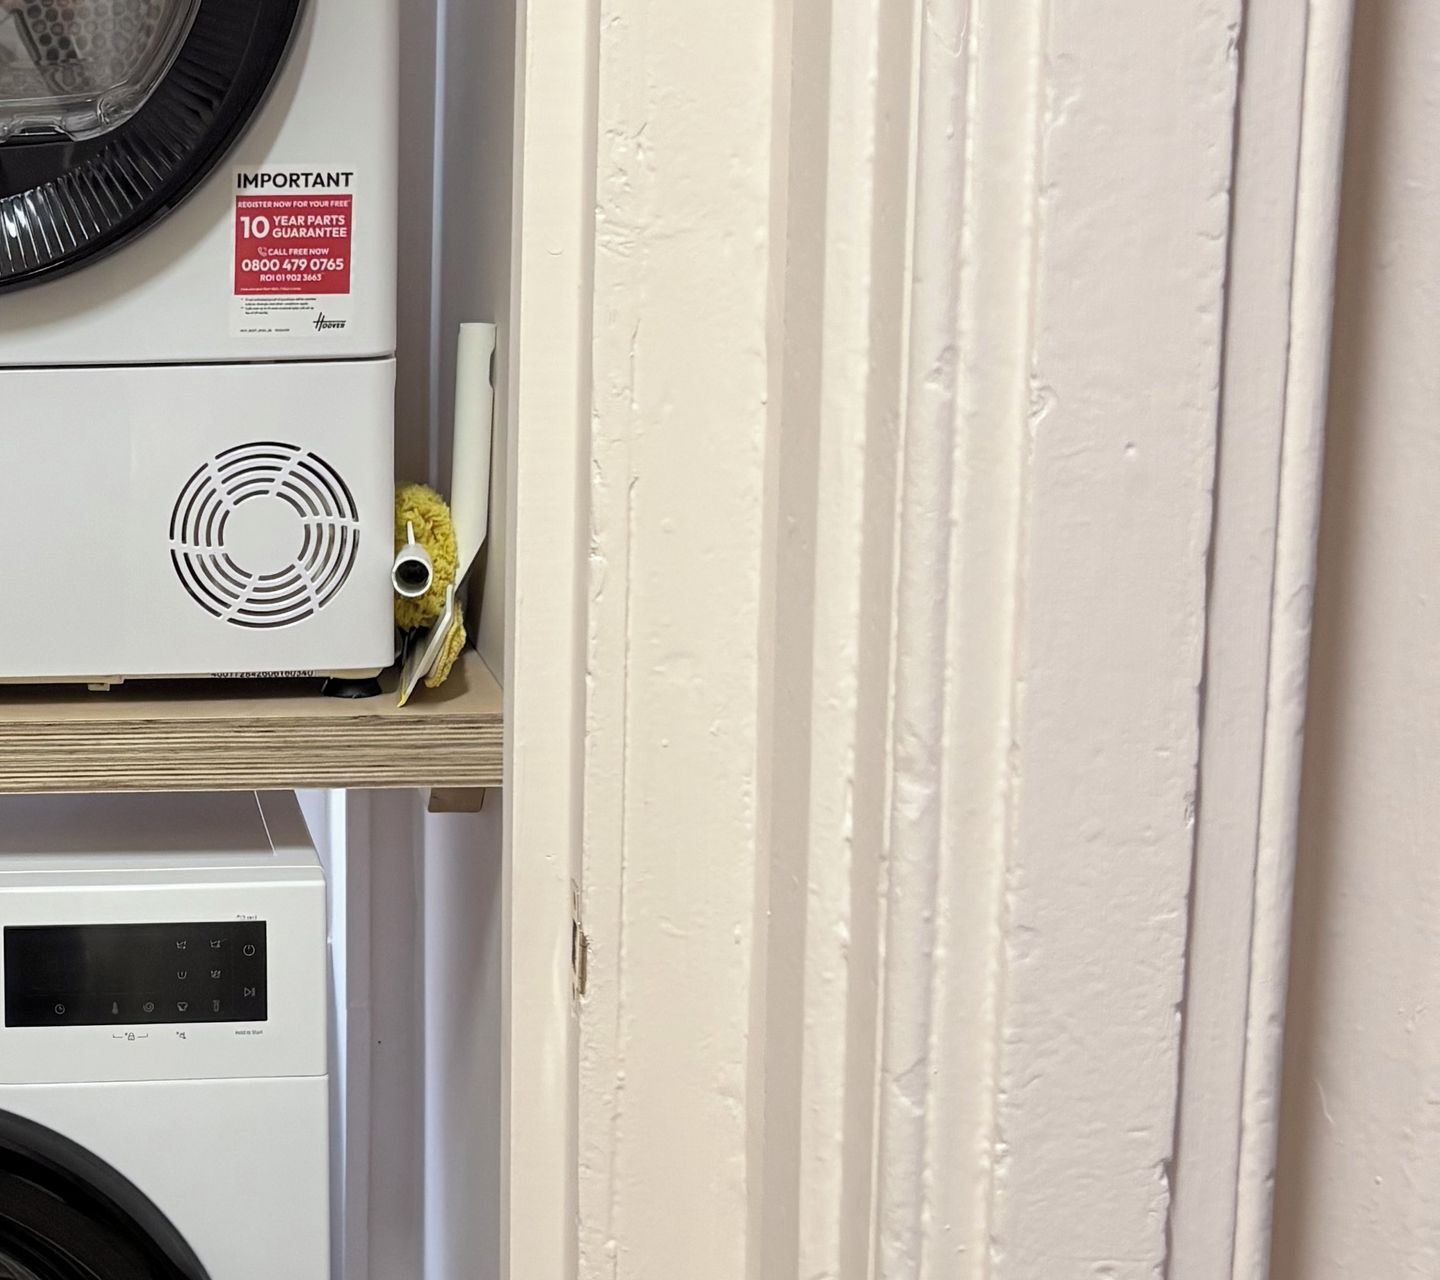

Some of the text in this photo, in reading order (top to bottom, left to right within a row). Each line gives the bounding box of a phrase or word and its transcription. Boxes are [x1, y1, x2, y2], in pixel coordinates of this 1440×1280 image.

[237, 172, 354, 189] IMPORTANT
[273, 215, 345, 226] YEAR PARTS
[240, 216, 270, 239] 10
[272, 227, 347, 238] GUARANTEE
[242, 258, 344, 271] 0800 479 0765
[260, 274, 275, 282] ROI
[313, 312, 346, 331] HOOVER
